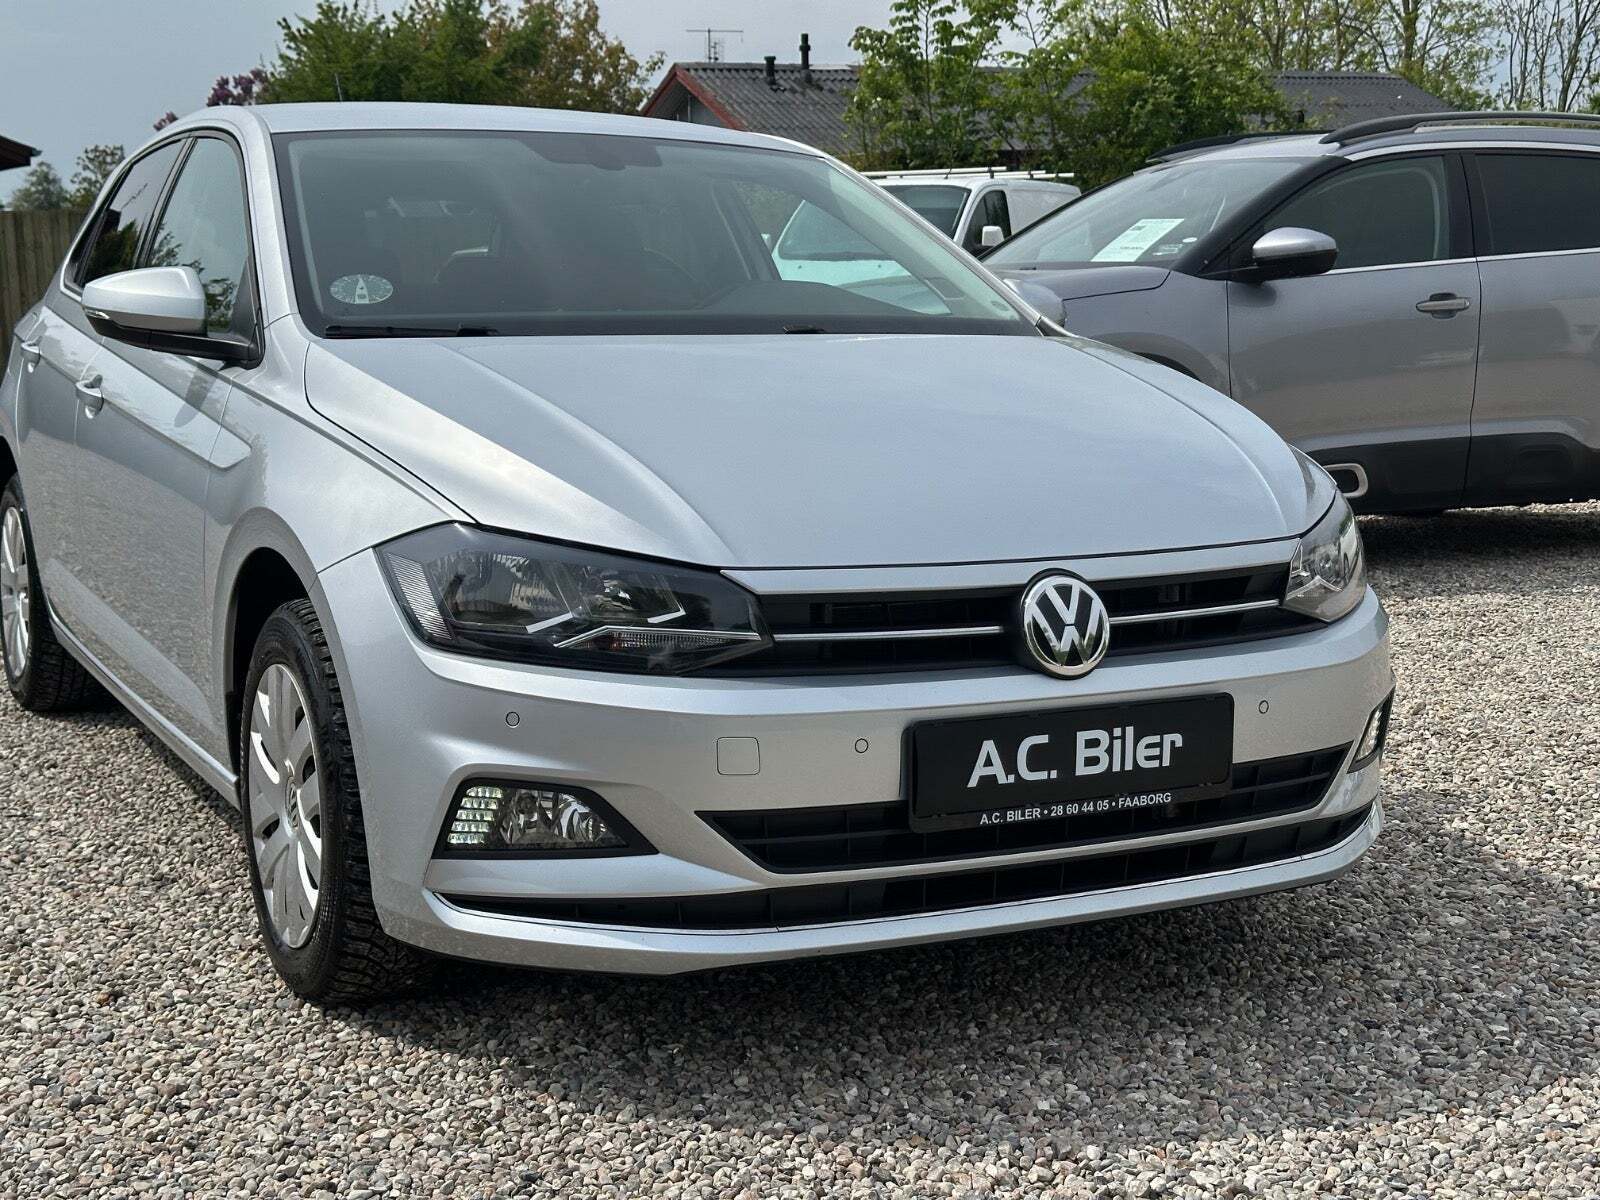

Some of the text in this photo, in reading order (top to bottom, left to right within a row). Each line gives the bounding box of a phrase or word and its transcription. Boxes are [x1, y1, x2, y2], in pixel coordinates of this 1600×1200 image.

[967, 726, 1183, 788] A.C. Biler
[980, 792, 1172, 825] A.C. BILER 28 60 44 05 FAABORG
